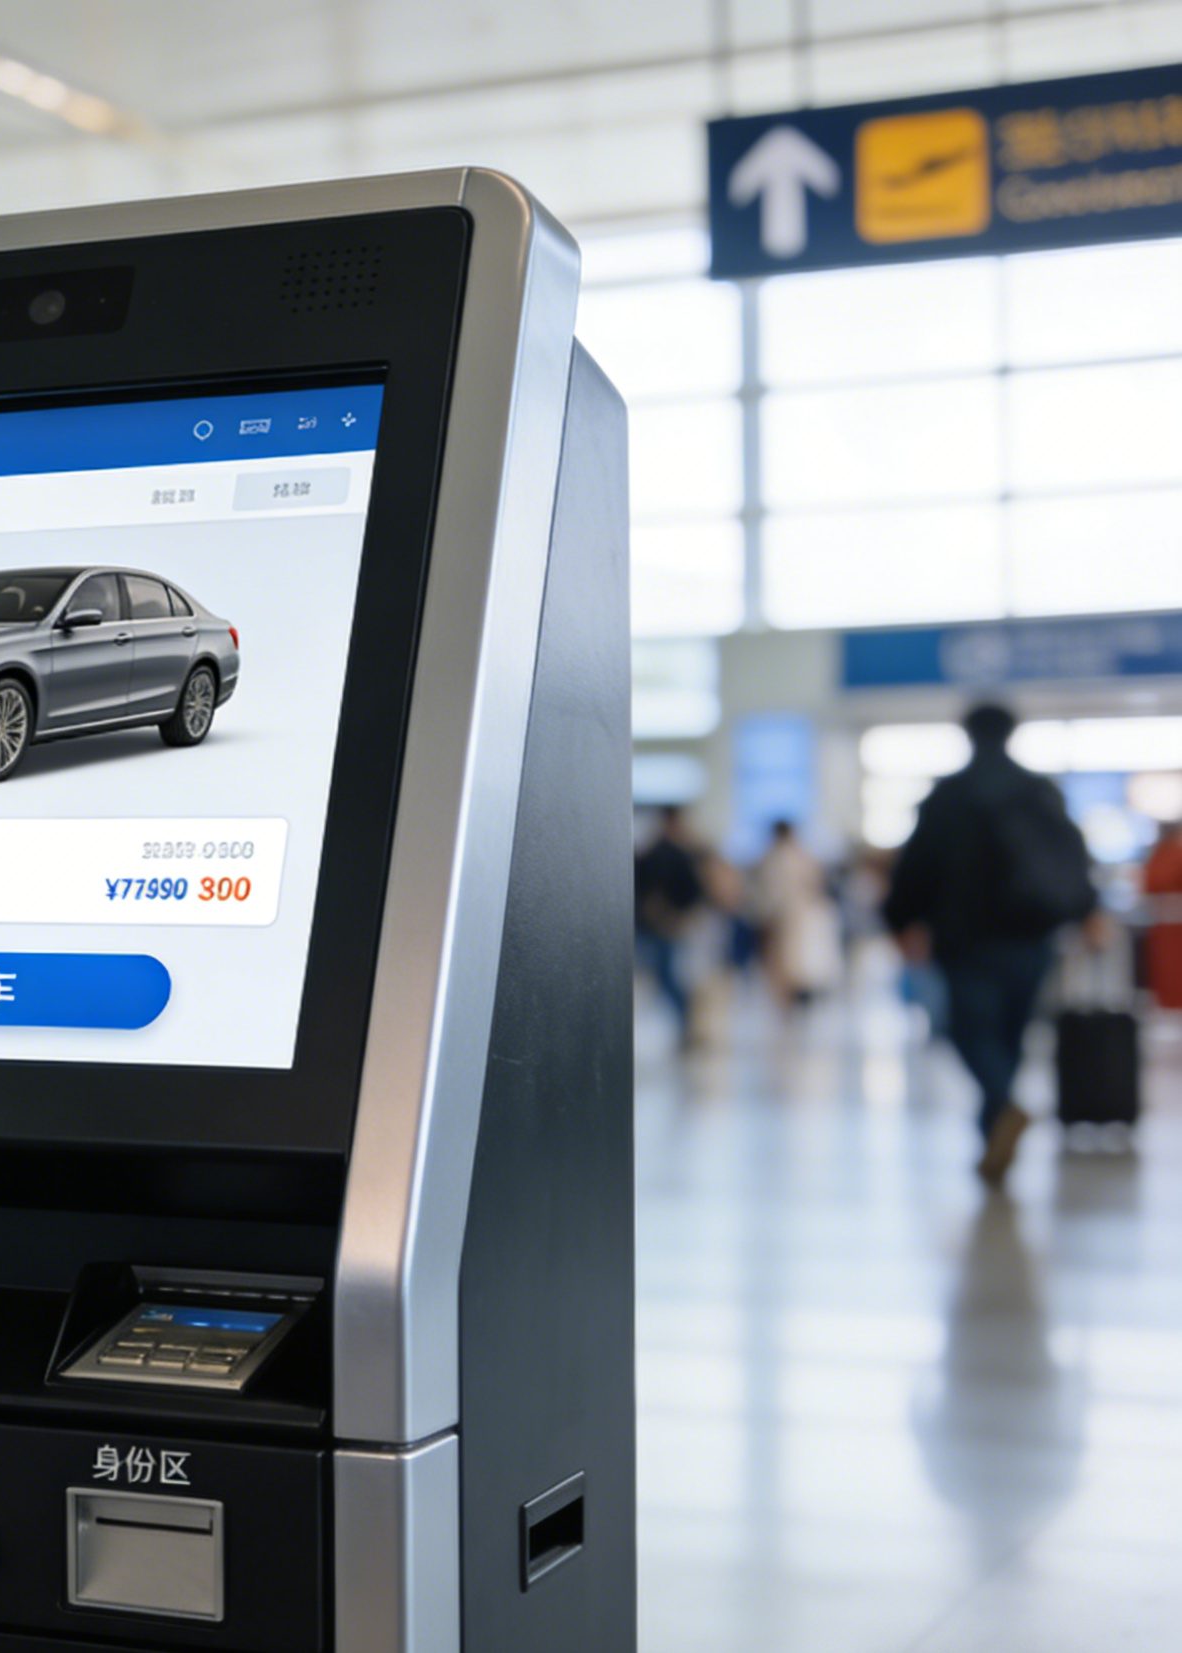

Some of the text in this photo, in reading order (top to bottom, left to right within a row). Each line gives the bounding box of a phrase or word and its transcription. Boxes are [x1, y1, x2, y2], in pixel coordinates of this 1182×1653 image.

[197, 875, 252, 902] 300
[91, 1443, 192, 1486] 身份区
